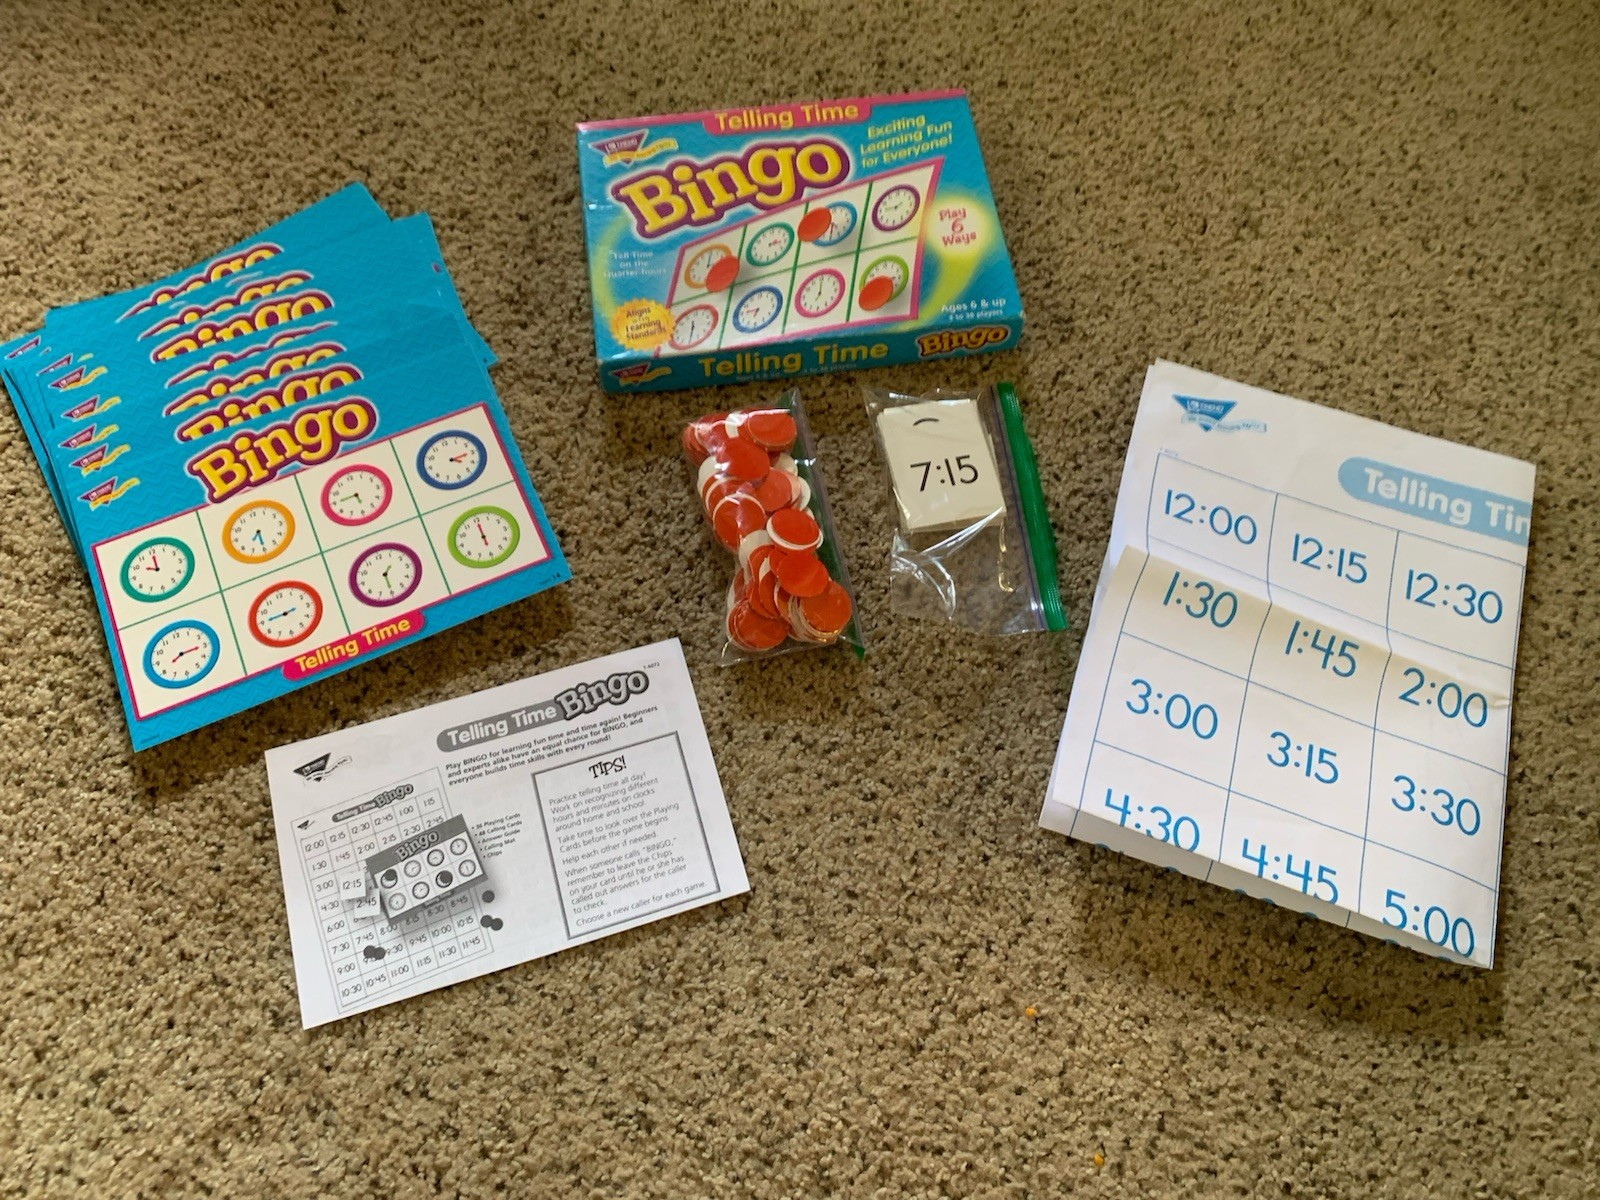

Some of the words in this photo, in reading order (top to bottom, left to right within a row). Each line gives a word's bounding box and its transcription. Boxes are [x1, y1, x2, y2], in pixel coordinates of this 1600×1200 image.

[716, 109, 793, 131] Telling
[802, 103, 859, 125] Time
[868, 115, 925, 138] Exciting
[860, 130, 922, 154] Learning
[927, 121, 952, 135] Fun
[862, 155, 878, 168] for
[883, 134, 952, 162] Everyone!
[617, 139, 846, 235] Bingo
[940, 208, 966, 220] Play
[951, 219, 963, 233] 6
[943, 231, 976, 246] Ways
[942, 304, 967, 313] Ages
[971, 300, 977, 309] 6
[992, 298, 1006, 306] up
[977, 309, 1003, 318] players
[919, 326, 1007, 357] Bingo
[700, 352, 801, 378] Telling
[814, 342, 889, 365] Time
[189, 400, 374, 499] Bingo
[910, 455, 979, 492] 7:15
[1364, 467, 1472, 525] Telling
[1164, 489, 1258, 545] 12:00
[1292, 534, 1368, 585] 12:15
[1406, 570, 1502, 625] 12:30
[295, 639, 360, 672] Telling
[361, 619, 411, 646] Time
[1163, 571, 1238, 628] 1:30
[1286, 621, 1360, 677] 1:45
[1399, 667, 1488, 728] 2:00
[447, 718, 509, 746] Telling
[511, 705, 557, 728] Time
[556, 671, 648, 719] Bingo
[445, 762, 461, 770] Play
[463, 754, 488, 765] BINGO
[501, 742, 532, 755] learning
[533, 738, 547, 746] fun
[548, 733, 564, 741] time
[566, 727, 580, 736] and
[581, 723, 597, 732] time
[599, 715, 621, 727] again!
[623, 706, 658, 720] Beginners
[448, 769, 462, 778] and
[463, 762, 491, 774] experts
[493, 757, 510, 765] alike
[511, 751, 529, 760] have
[542, 740, 562, 751] equal
[564, 734, 589, 745] chance
[602, 722, 628, 734] BINGO,
[630, 717, 643, 726] and
[449, 772, 483, 786] everyone
[484, 765, 508, 776] builds
[509, 760, 526, 769] time
[527, 754, 545, 764] skills
[547, 749, 564, 758] with
[565, 743, 585, 753] every
[587, 734, 611, 746] round!
[588, 755, 627, 779] TIPS!
[1126, 680, 1218, 739] 3:00
[1268, 731, 1339, 785] 3:15
[1392, 776, 1481, 836] 3:30
[375, 784, 413, 808] Bingo
[549, 793, 577, 806] Practice
[578, 786, 602, 797] telling
[603, 781, 619, 790] time
[621, 777, 629, 785] all
[630, 772, 646, 782] day!
[551, 804, 570, 814] Work
[584, 788, 627, 805] recognizing
[628, 778, 658, 792] different
[305, 840, 324, 852] 12:00
[329, 831, 346, 843] 12:15
[351, 822, 370, 834] 12:30
[374, 814, 394, 826] 12:45
[399, 805, 414, 816] 1:00
[423, 797, 435, 807] 1:15
[552, 813, 574, 823] hours
[576, 807, 590, 817] and
[591, 799, 620, 812] minutes
[555, 819, 582, 832] around
[583, 813, 604, 824] home
[606, 807, 620, 817] and
[558, 834, 575, 844] Take
[577, 829, 593, 838] time
[623, 816, 638, 824] over
[640, 811, 652, 819] the
[653, 803, 680, 815] Playing
[312, 860, 327, 871] 1:30
[335, 851, 351, 863] 1:45
[357, 842, 375, 855] 2:00
[382, 834, 397, 845] 2:15
[404, 824, 421, 837] 2:30
[427, 815, 444, 828] 2:45
[395, 831, 439, 862] Bingo
[559, 842, 581, 853] Cards
[582, 835, 607, 846] before
[608, 830, 621, 838] the
[622, 824, 643, 836] game
[562, 855, 580, 865] Help
[581, 849, 599, 860] each
[600, 843, 620, 854] other
[565, 866, 588, 877] When
[624, 850, 641, 859] calls
[567, 870, 605, 887] remember
[637, 857, 650, 865] the
[651, 850, 673, 861] Chips
[1105, 788, 1200, 853] 4:30
[1243, 838, 1339, 905] 4:45
[1382, 890, 1474, 957] 5:00
[316, 880, 334, 892] 3:00
[342, 878, 362, 890] 12:15
[571, 892, 593, 905] called
[595, 888, 608, 898] out
[610, 880, 640, 894] answers
[641, 875, 652, 883] for
[653, 871, 666, 879] the
[667, 864, 687, 875] caller
[581, 882, 598, 894] your
[599, 875, 616, 887] card
[321, 900, 339, 911] 4:30
[356, 896, 377, 909] 2:45
[576, 914, 605, 926] Choose
[613, 907, 629, 915] new
[631, 899, 650, 909] caller
[665, 888, 683, 899] each
[327, 920, 345, 933] 6:00
[332, 942, 350, 955] 7:30
[356, 932, 374, 945] 7:45
[380, 922, 398, 936] 8:00
[427, 904, 445, 917] 8:30
[337, 963, 356, 975] 9:00
[409, 934, 427, 946] 9:45
[431, 924, 452, 938] 10:00
[457, 915, 474, 928] 10:15
[342, 983, 362, 998] 10:30
[366, 974, 387, 988] 10:45
[391, 965, 409, 978] 11:00
[417, 956, 432, 968] 11:15
[439, 946, 457, 959] 11:30
[462, 936, 481, 949] 11:45
